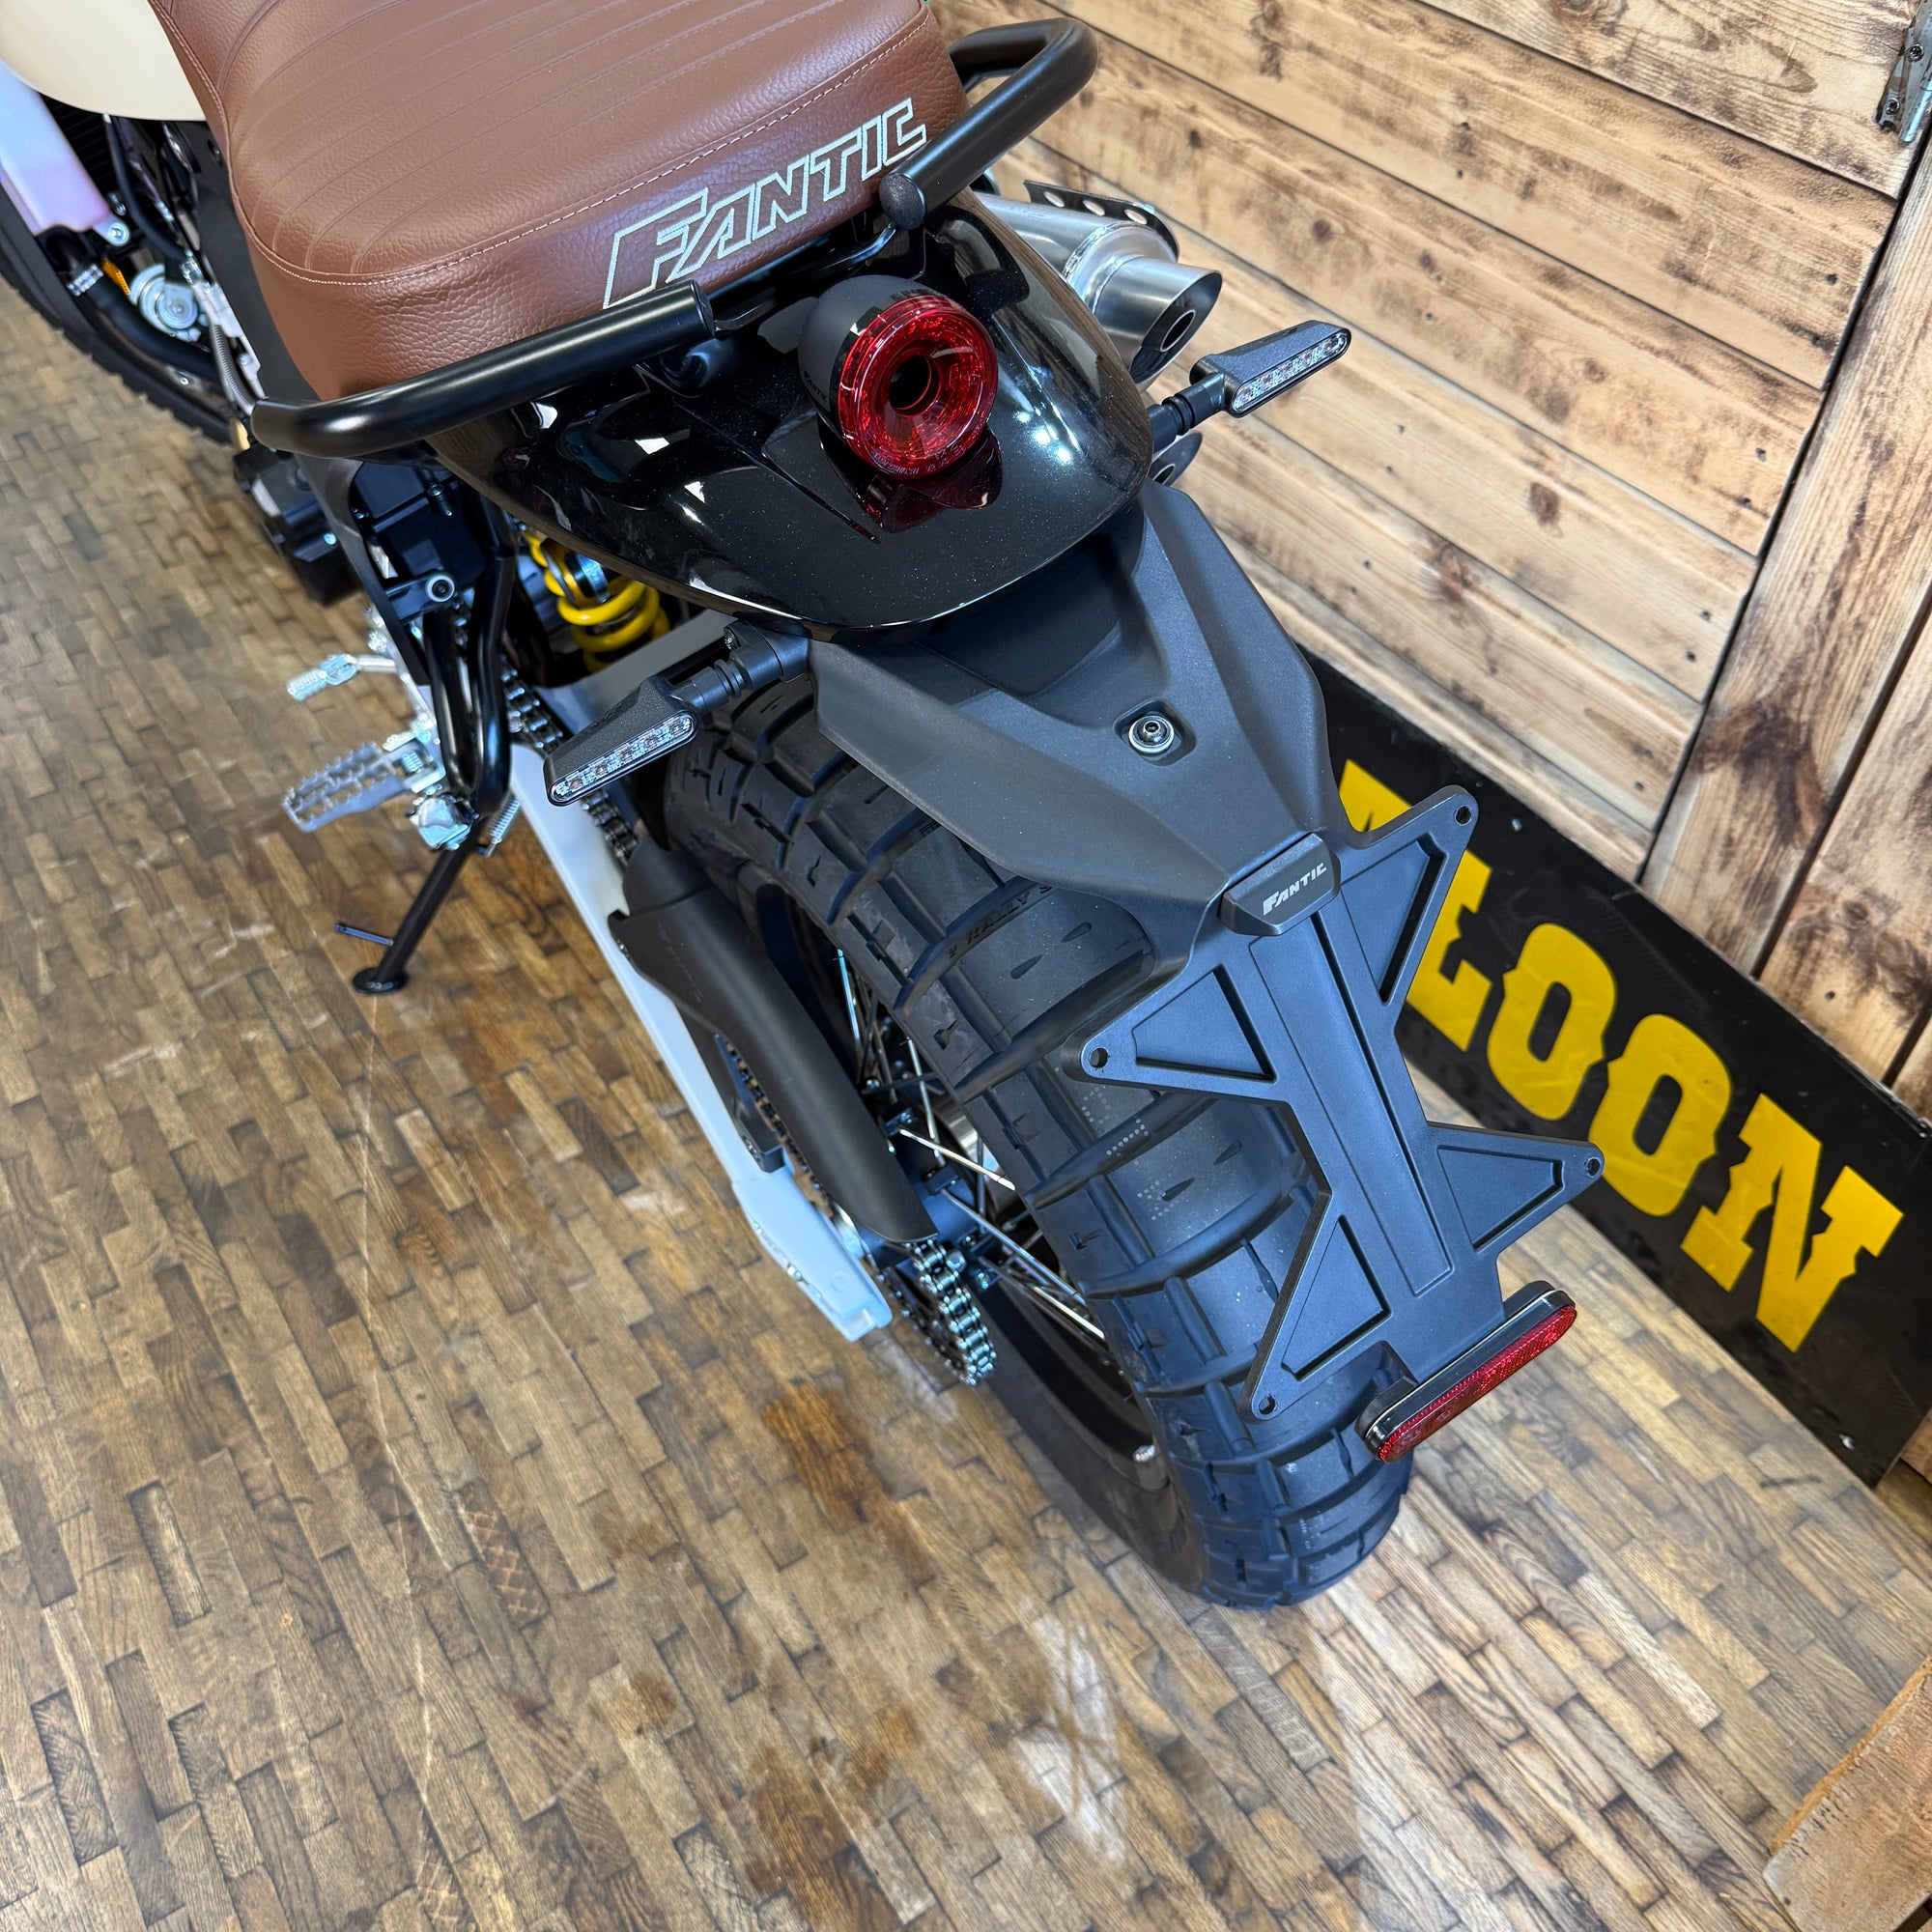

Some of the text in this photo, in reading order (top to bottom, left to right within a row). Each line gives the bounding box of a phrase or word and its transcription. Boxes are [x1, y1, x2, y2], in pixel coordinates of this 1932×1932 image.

[603, 98, 927, 309] FANTIC
[1263, 863, 1327, 916] FANTIC
[1338, 759, 1904, 1352] LOON
